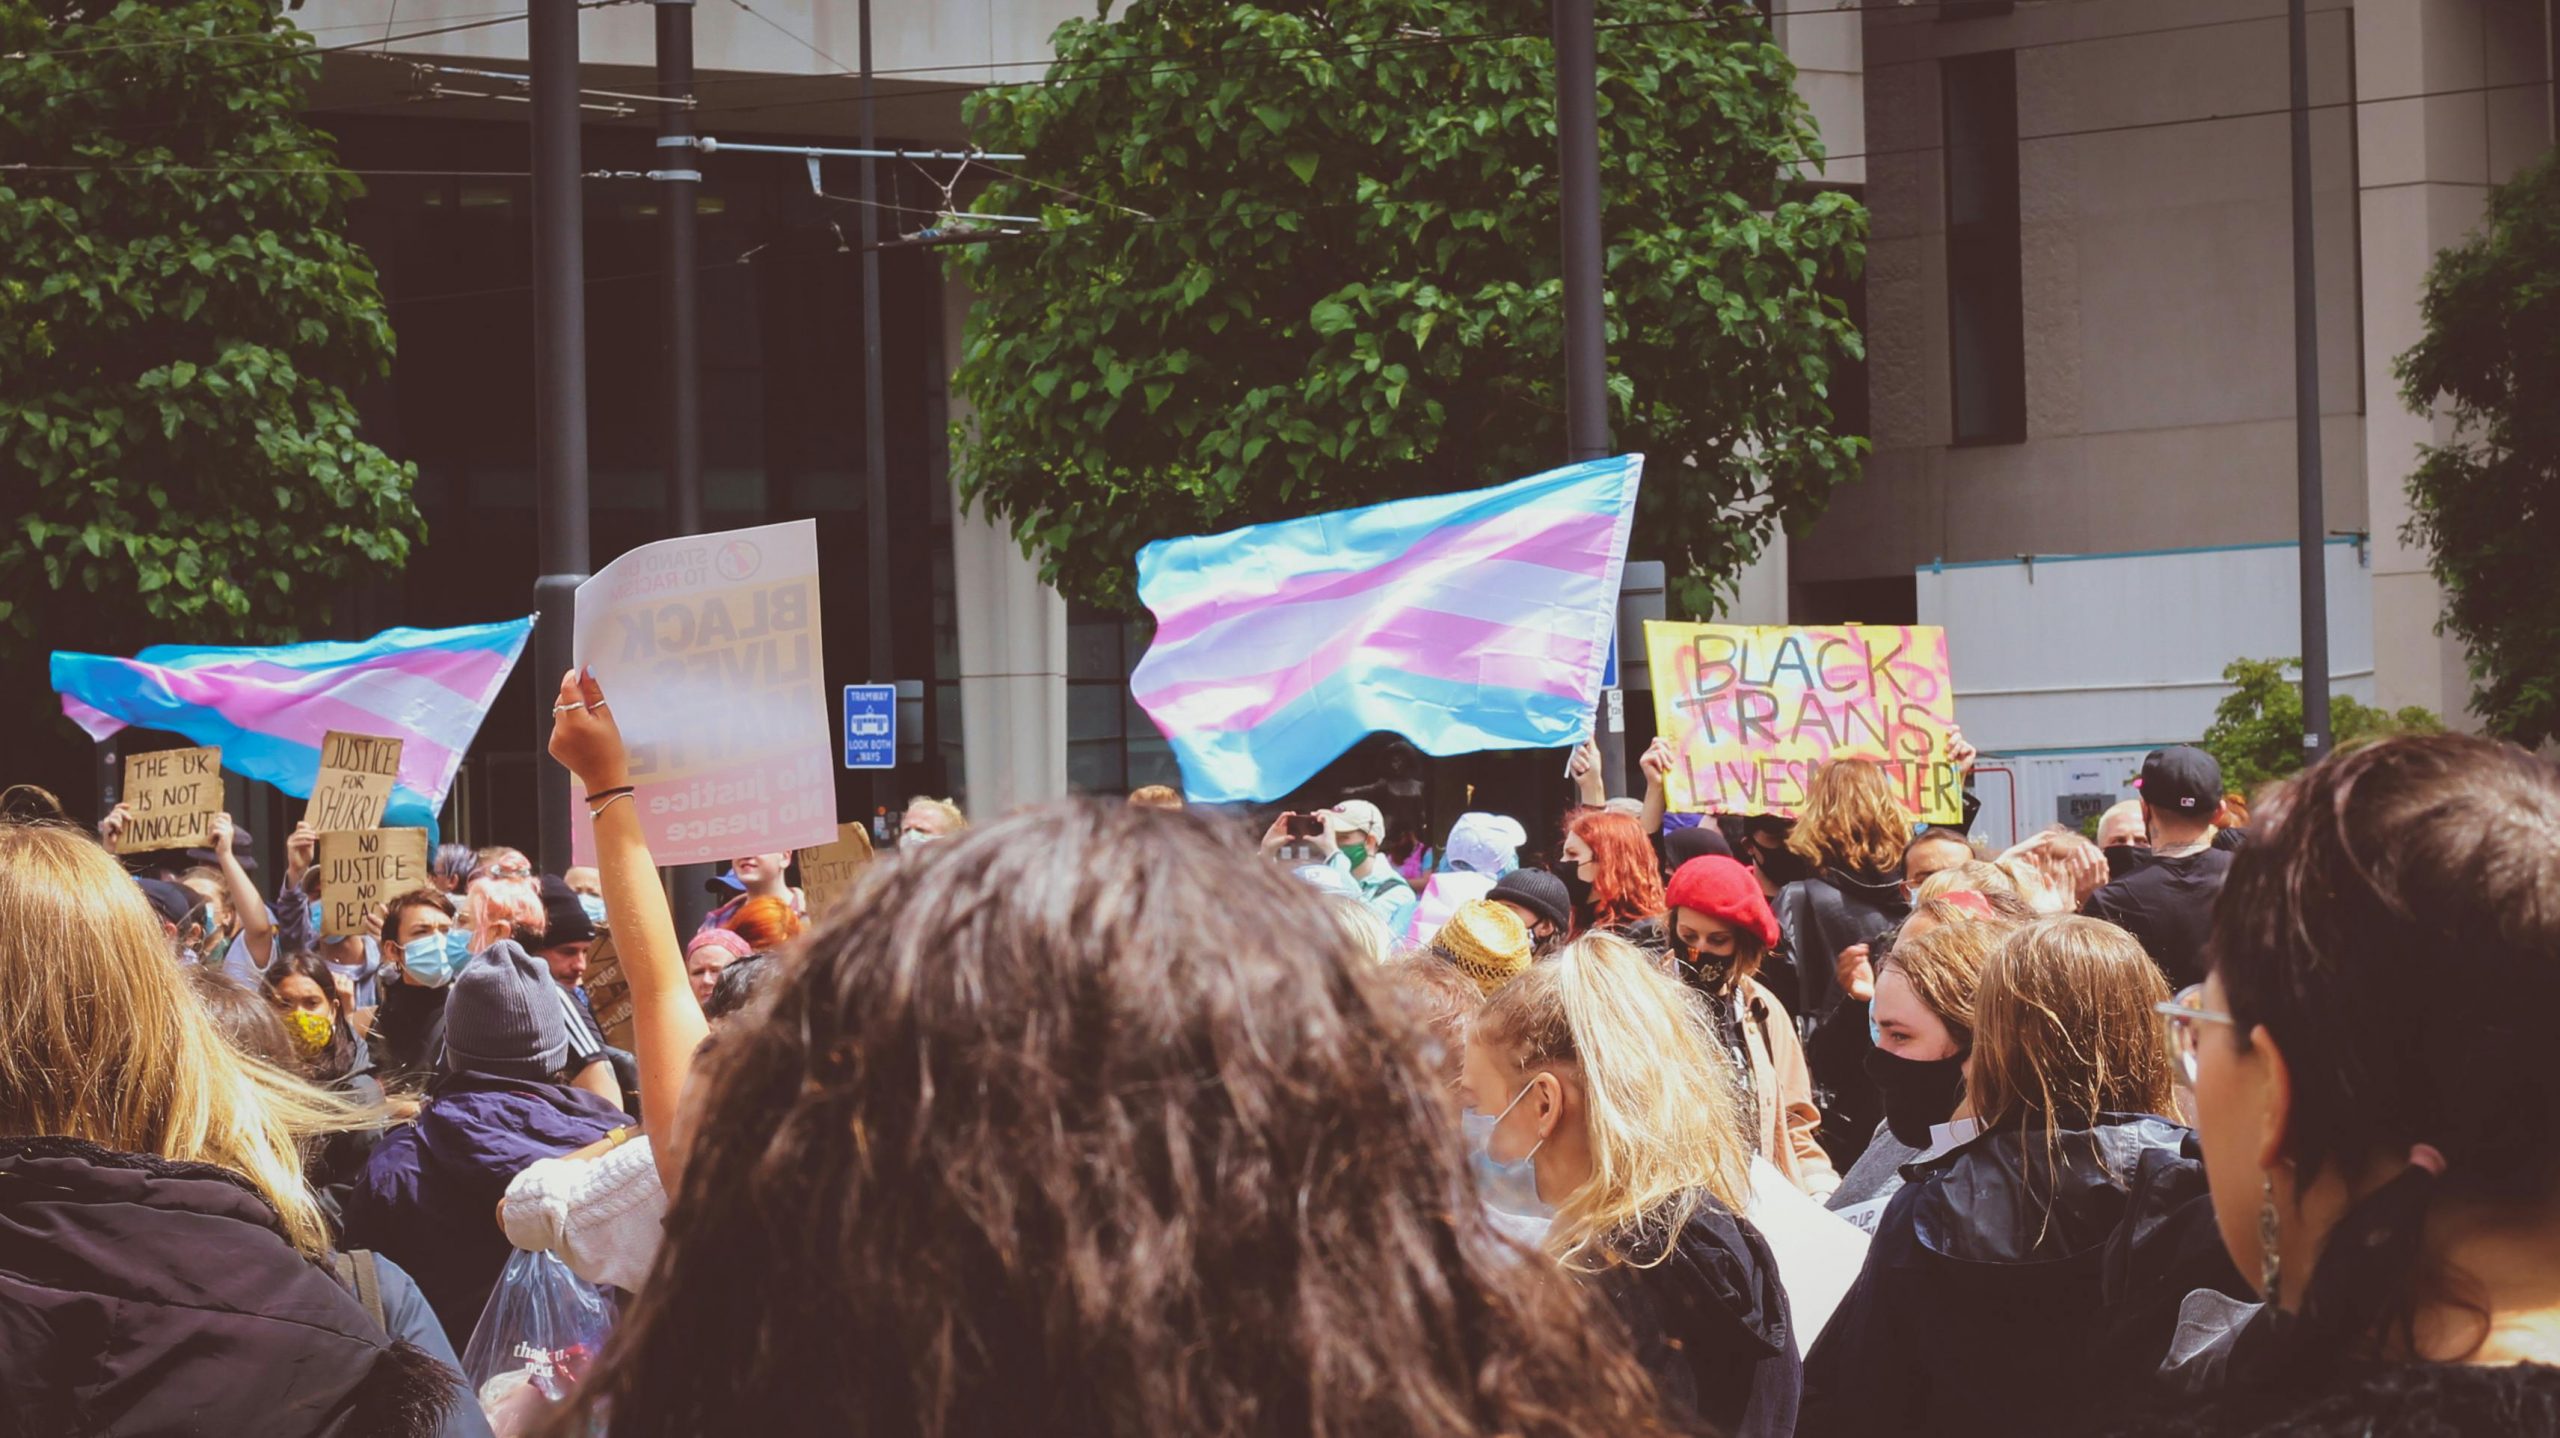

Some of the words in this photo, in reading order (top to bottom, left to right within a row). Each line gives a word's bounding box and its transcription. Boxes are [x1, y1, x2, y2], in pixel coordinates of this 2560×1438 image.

[1692, 634, 1908, 698] BLACK
[851, 691, 889, 701] TRAMWAY
[1675, 689, 1935, 758] TRANS
[327, 737, 398, 775] JUSTICE
[848, 739, 870, 750] LOOK
[871, 739, 892, 750] BOTH
[133, 757, 169, 779] THE
[183, 754, 209, 775] UK
[341, 774, 365, 790] FOR
[1684, 755, 1805, 807] LIVES
[139, 789, 153, 811] IS
[163, 783, 201, 807] NOT
[313, 786, 379, 830] SHUKRI
[126, 811, 215, 844] INNOCENT
[358, 834, 378, 853] NO
[327, 855, 411, 884] JUSTICE
[356, 884, 377, 901] NO
[513, 1341, 554, 1364] thank
